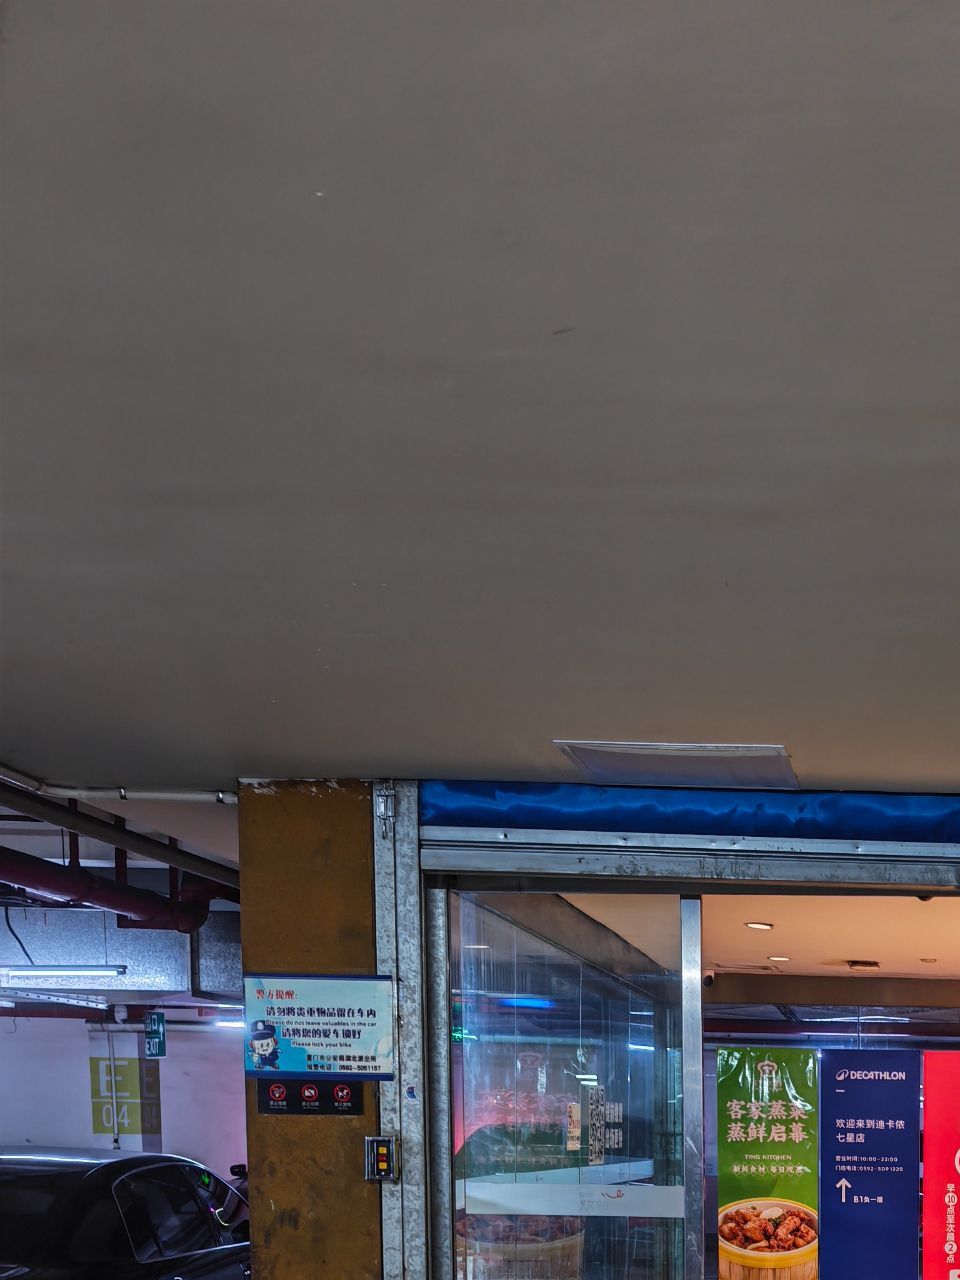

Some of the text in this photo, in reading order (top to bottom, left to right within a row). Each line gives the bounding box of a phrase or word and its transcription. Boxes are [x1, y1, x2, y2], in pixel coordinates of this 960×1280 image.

[266, 1006, 377, 1018] 请勿将贵重物品留在车内
[282, 1028, 361, 1039] 请将您的爱车锁好
[146, 1039, 159, 1055] EXIT
[98, 1061, 130, 1097] E
[850, 1070, 906, 1080] DECATHLON
[102, 1104, 130, 1128] 04
[727, 1100, 809, 1120] 客家蒸菜
[836, 1119, 905, 1130] 欢迎来到迪卡侬
[727, 1122, 809, 1143] 蒸鲜启幕
[836, 1133, 865, 1143] 七星店
